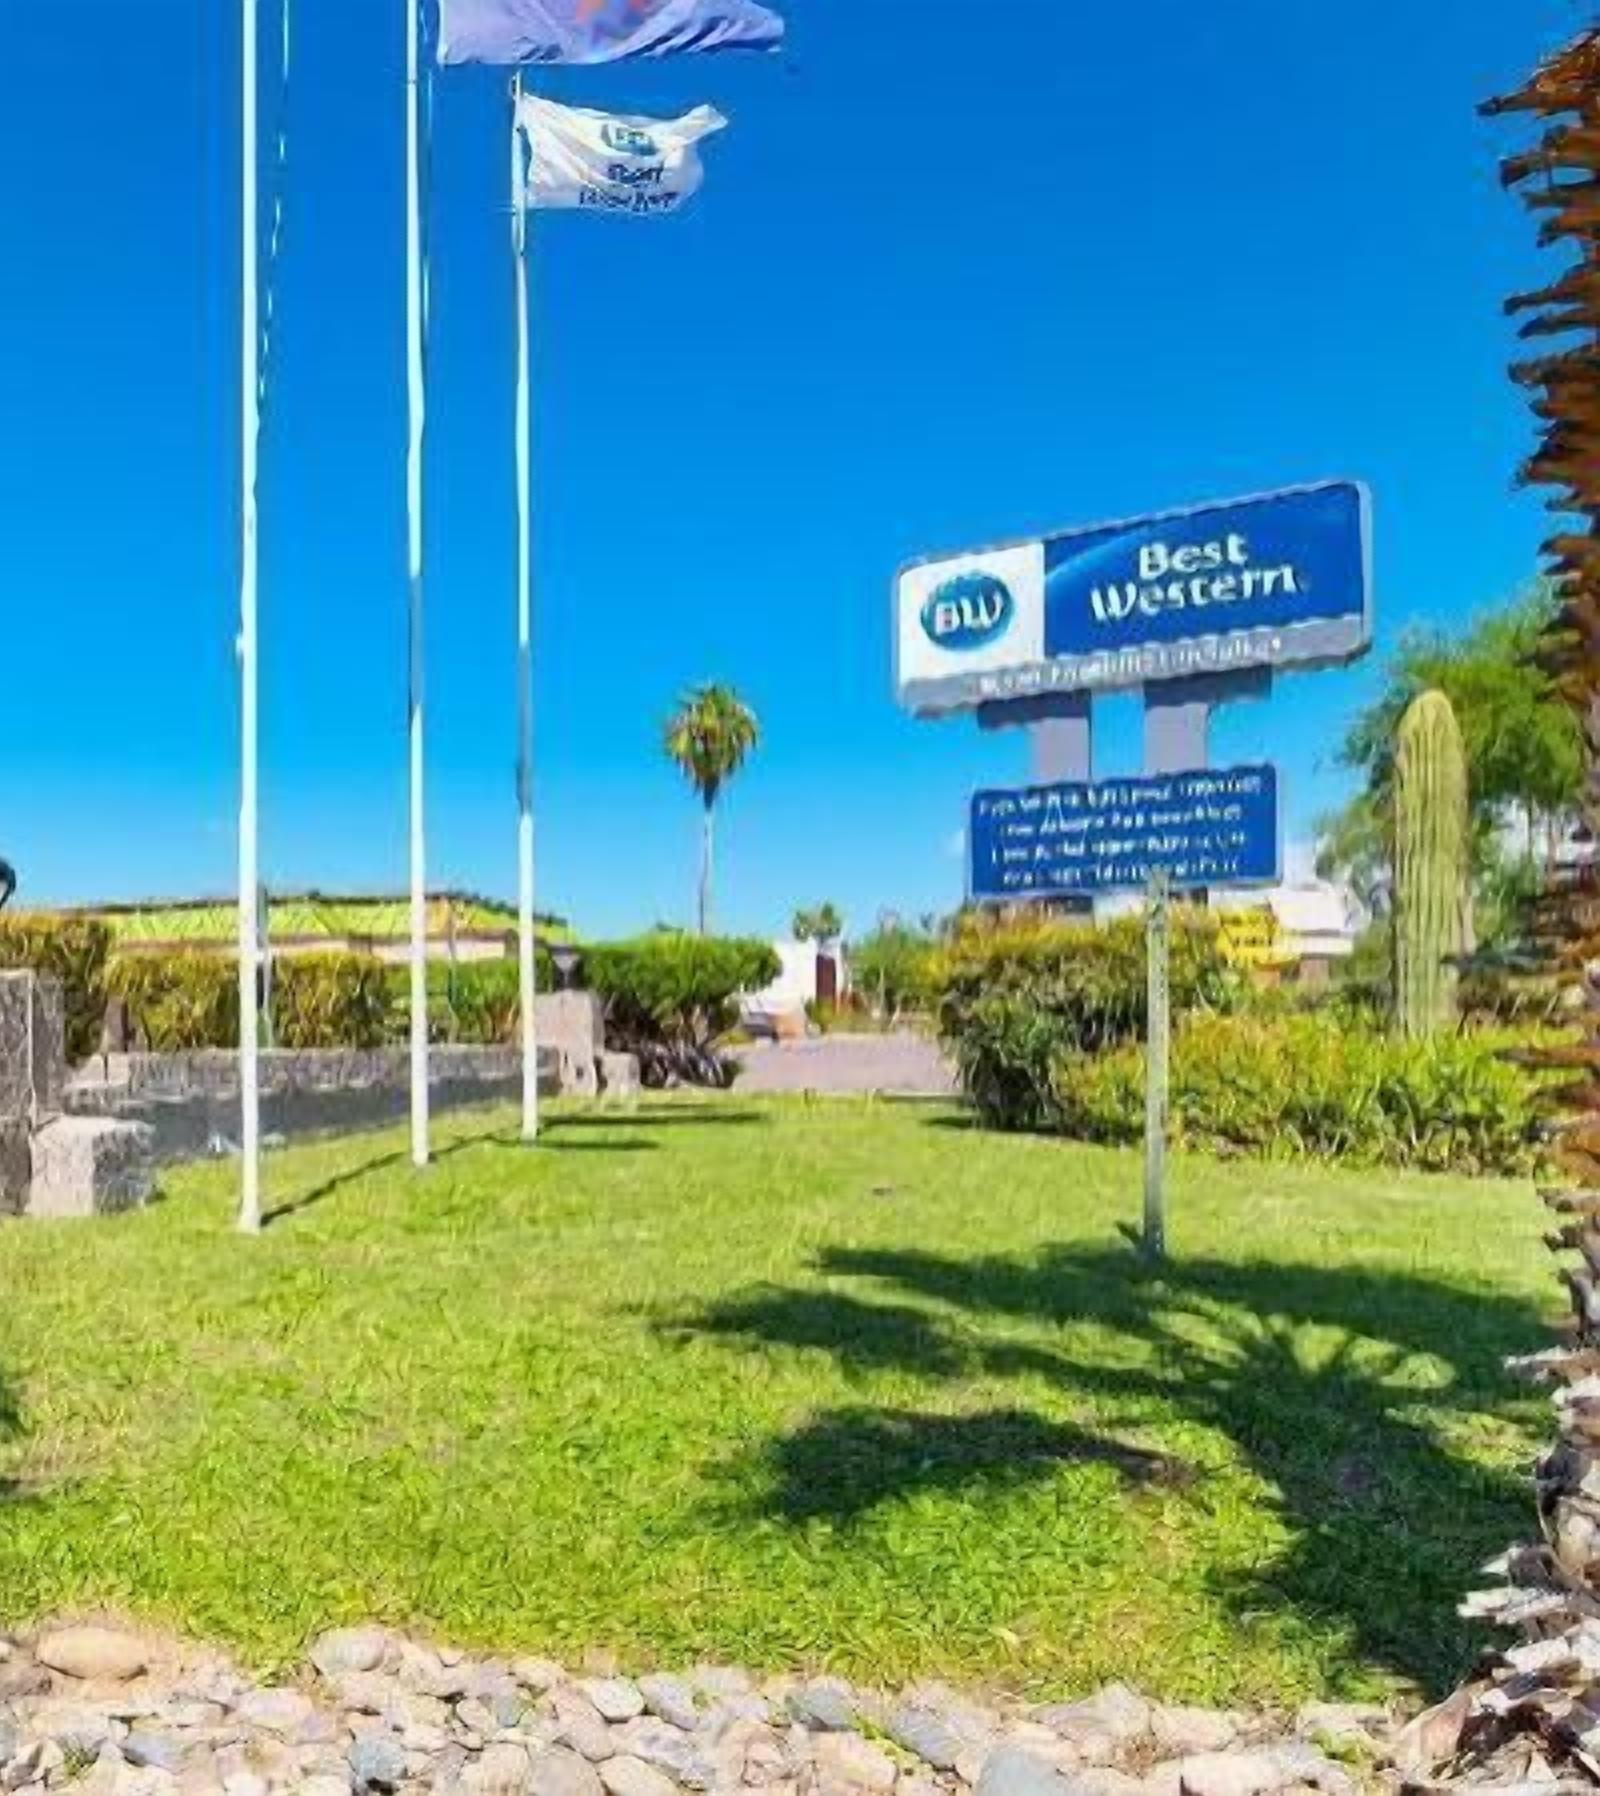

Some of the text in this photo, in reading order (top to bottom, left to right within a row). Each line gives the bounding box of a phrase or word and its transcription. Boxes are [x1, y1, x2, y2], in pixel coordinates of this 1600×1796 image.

[1138, 532, 1249, 581] Best
[933, 590, 1006, 636] BW
[1088, 562, 1302, 624] Western
